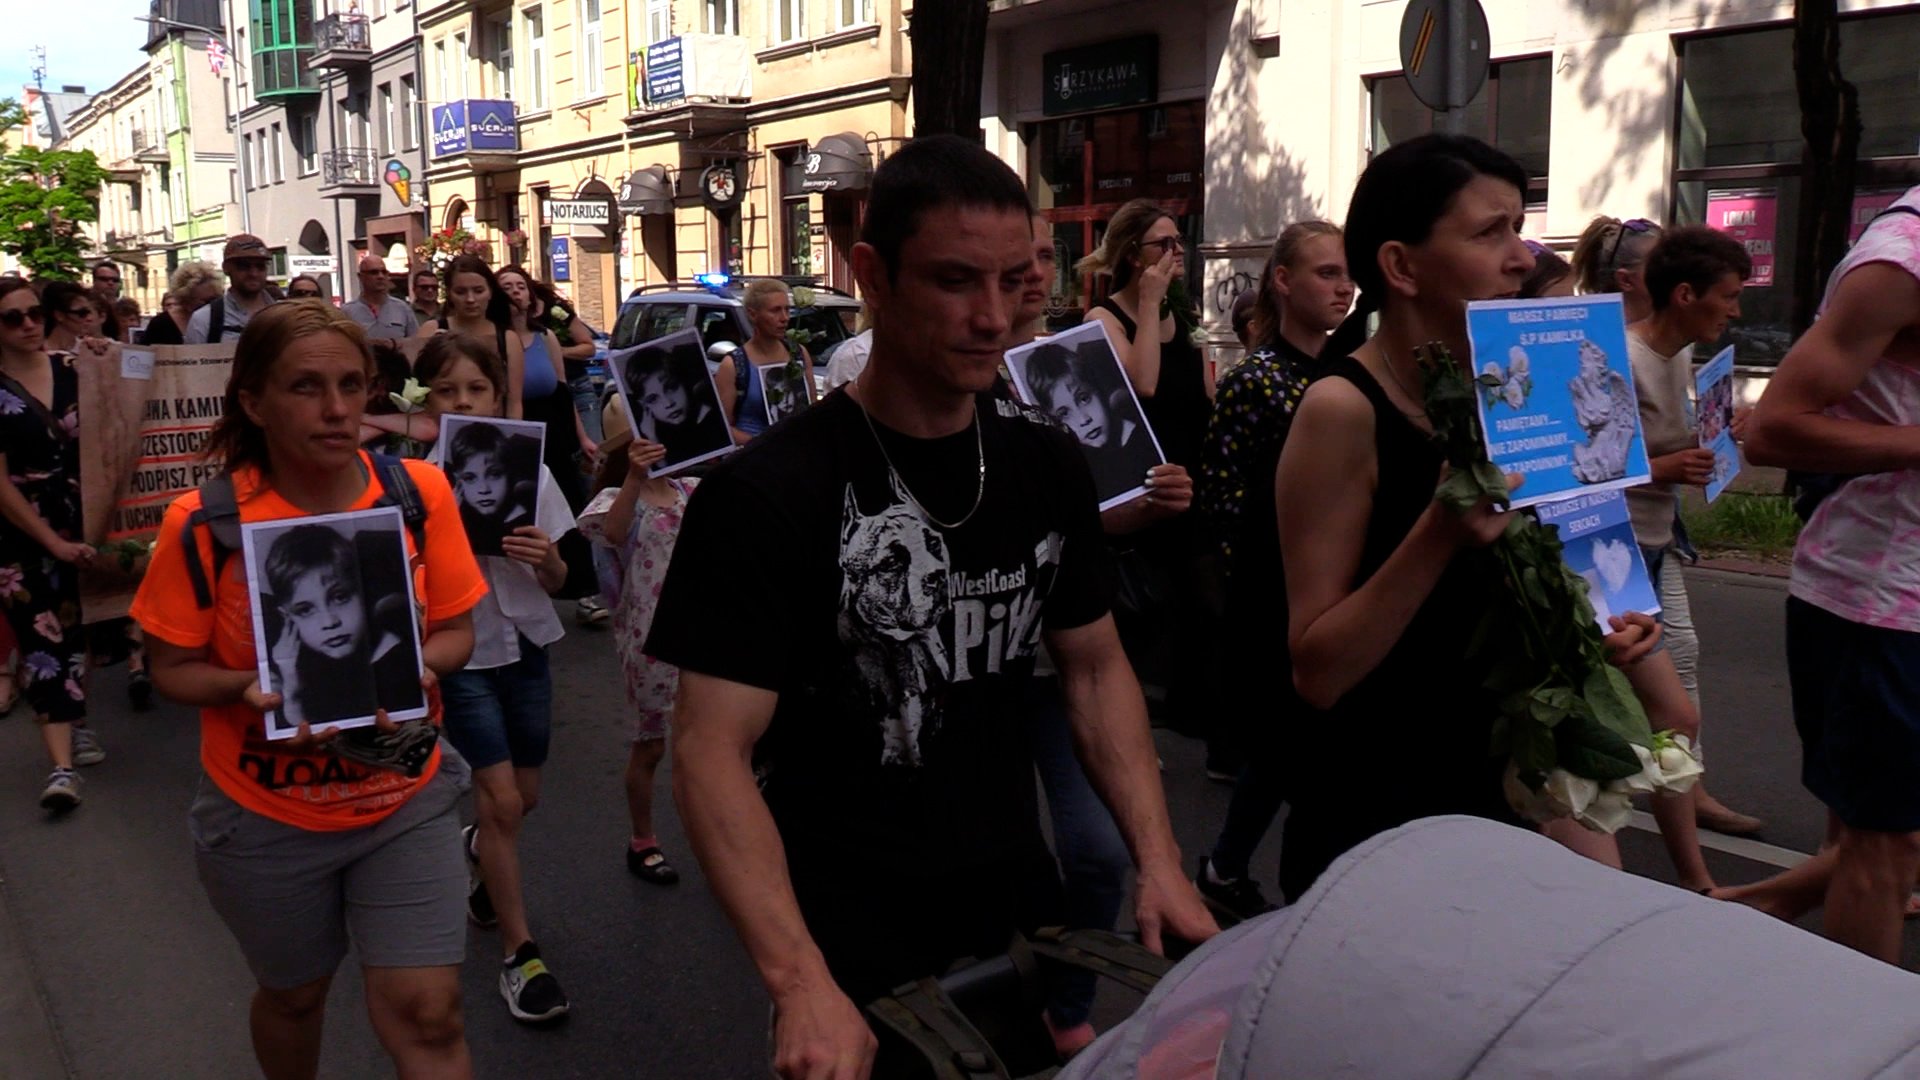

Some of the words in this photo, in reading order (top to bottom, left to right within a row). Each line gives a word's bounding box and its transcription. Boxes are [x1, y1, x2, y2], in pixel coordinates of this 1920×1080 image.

[551, 204, 609, 219] NOTARIUSZ
[1723, 210, 1757, 228] LOKAL
[1508, 309, 1544, 323] MARSZ
